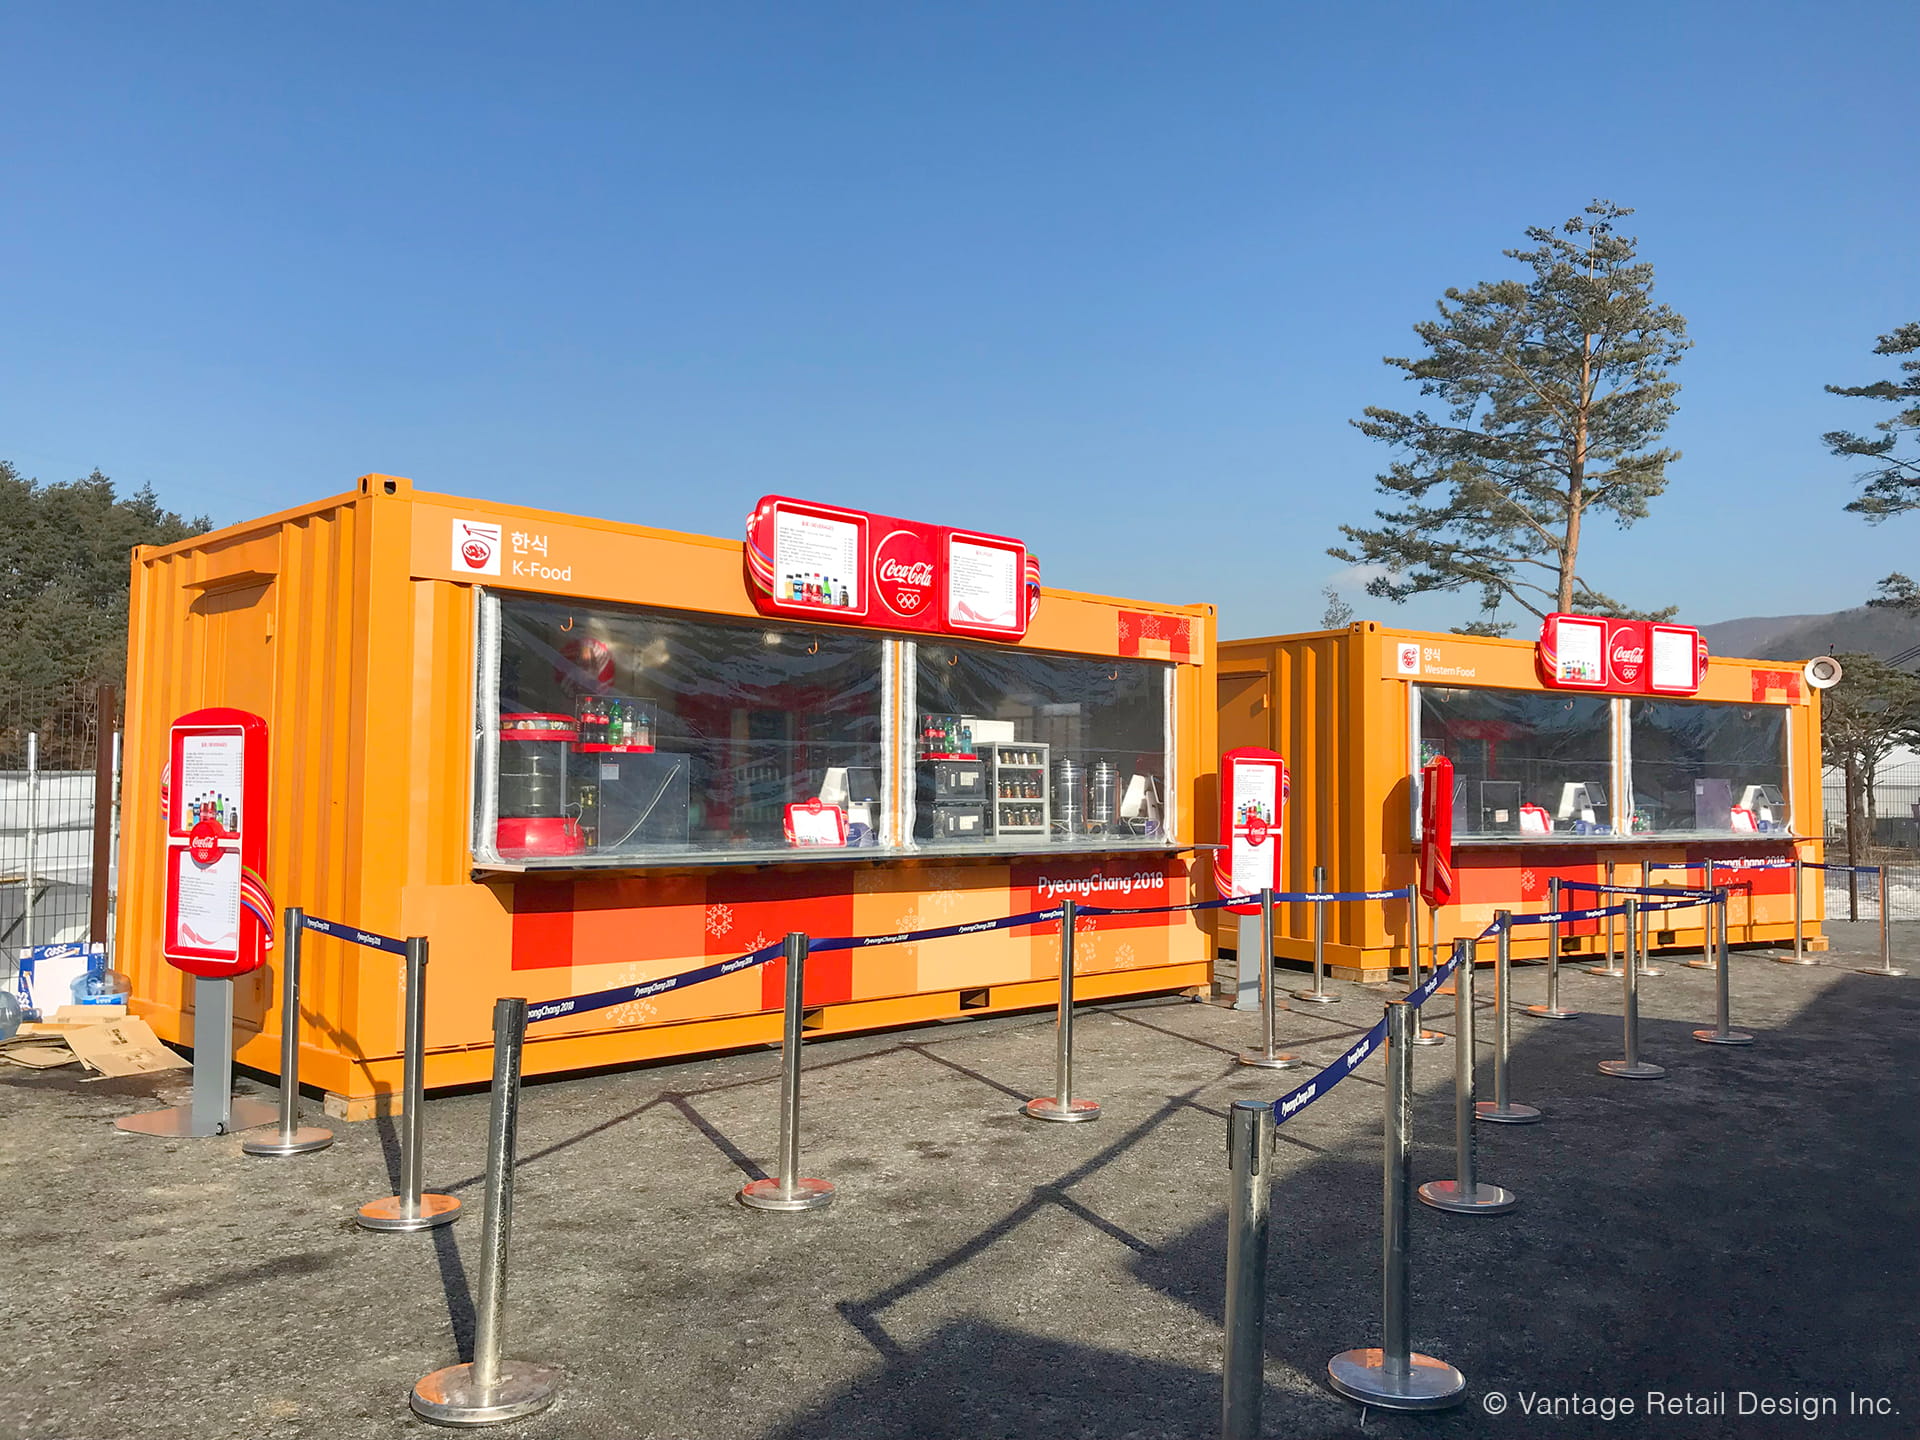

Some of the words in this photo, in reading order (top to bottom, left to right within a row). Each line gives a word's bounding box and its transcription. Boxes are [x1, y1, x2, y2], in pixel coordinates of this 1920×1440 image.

[511, 531, 548, 558] 한식
[512, 559, 572, 582] K-Food
[880, 558, 934, 587] Coca-Cola
[1423, 647, 1441, 662] 양식
[1424, 663, 1456, 676] Western
[1455, 666, 1476, 678] Food
[1037, 872, 1132, 899] PyeongChang
[1132, 871, 1164, 889] 2018
